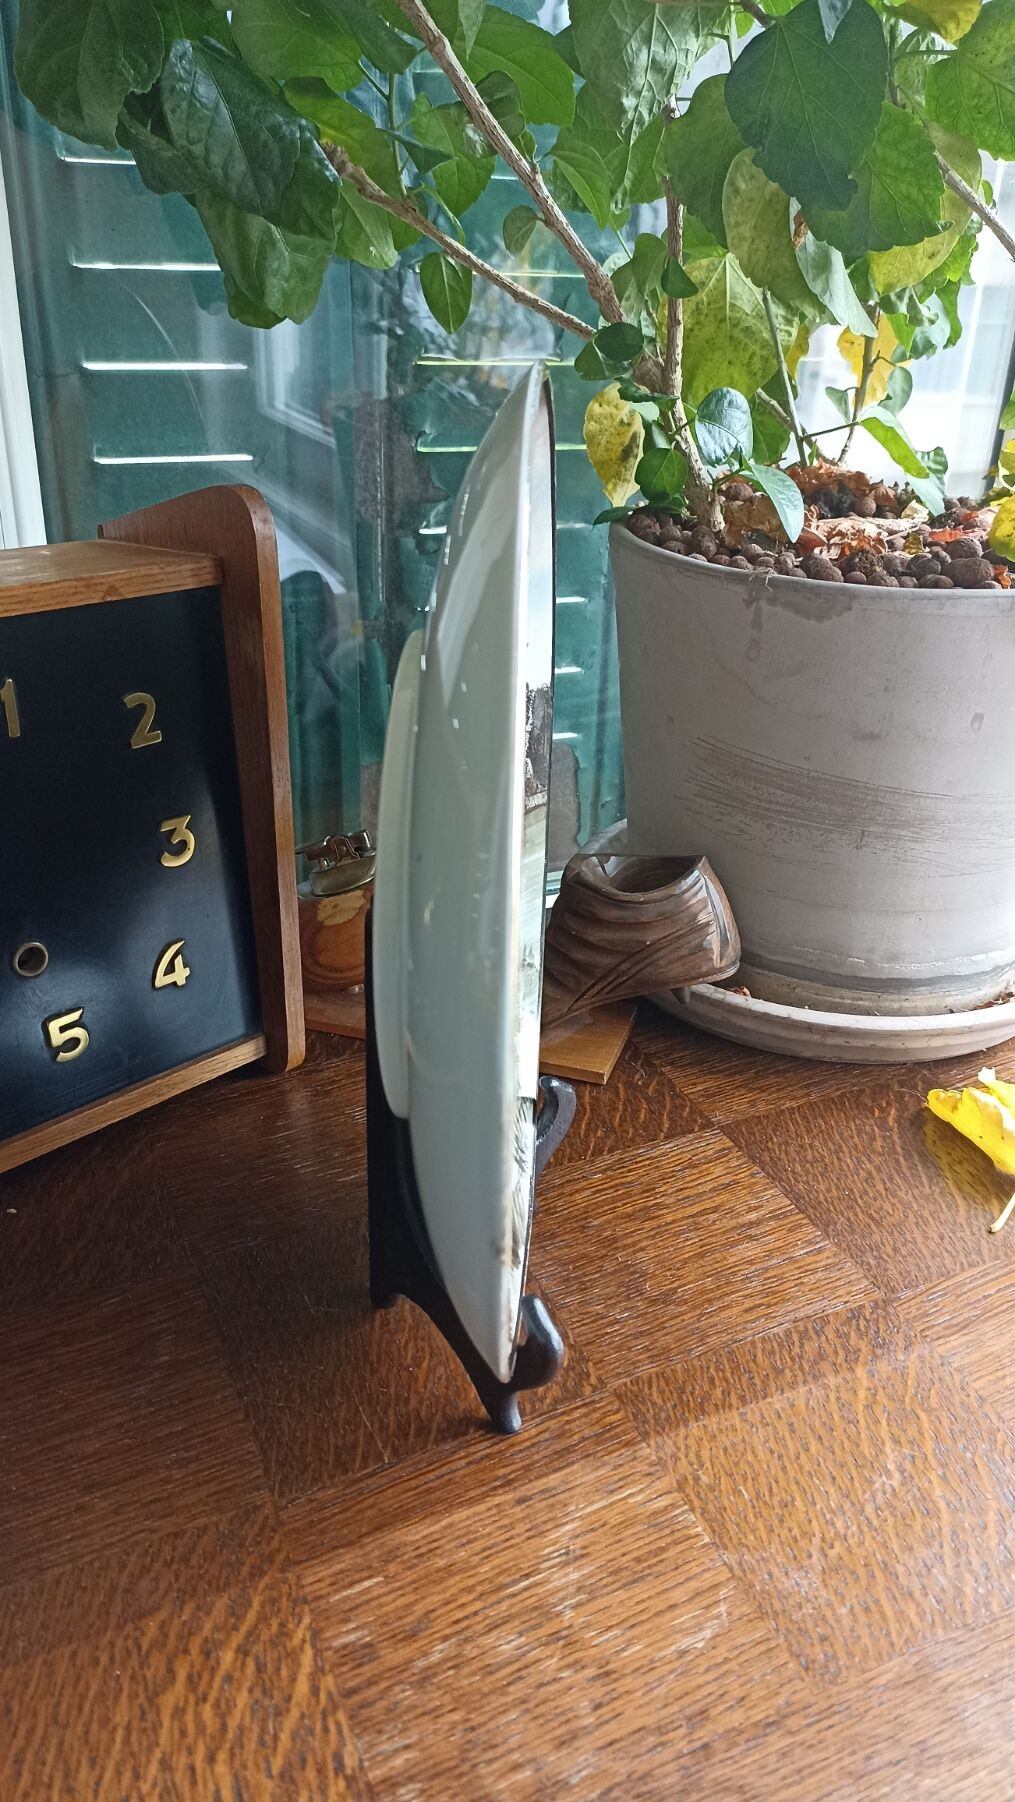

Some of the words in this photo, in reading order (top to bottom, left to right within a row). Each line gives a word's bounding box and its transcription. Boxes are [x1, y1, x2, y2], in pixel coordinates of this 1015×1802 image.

[0, 678, 20, 737] 1
[123, 692, 162, 749] 2
[160, 814, 196, 867] 3
[154, 939, 190, 989] 4
[46, 1007, 89, 1062] 5
